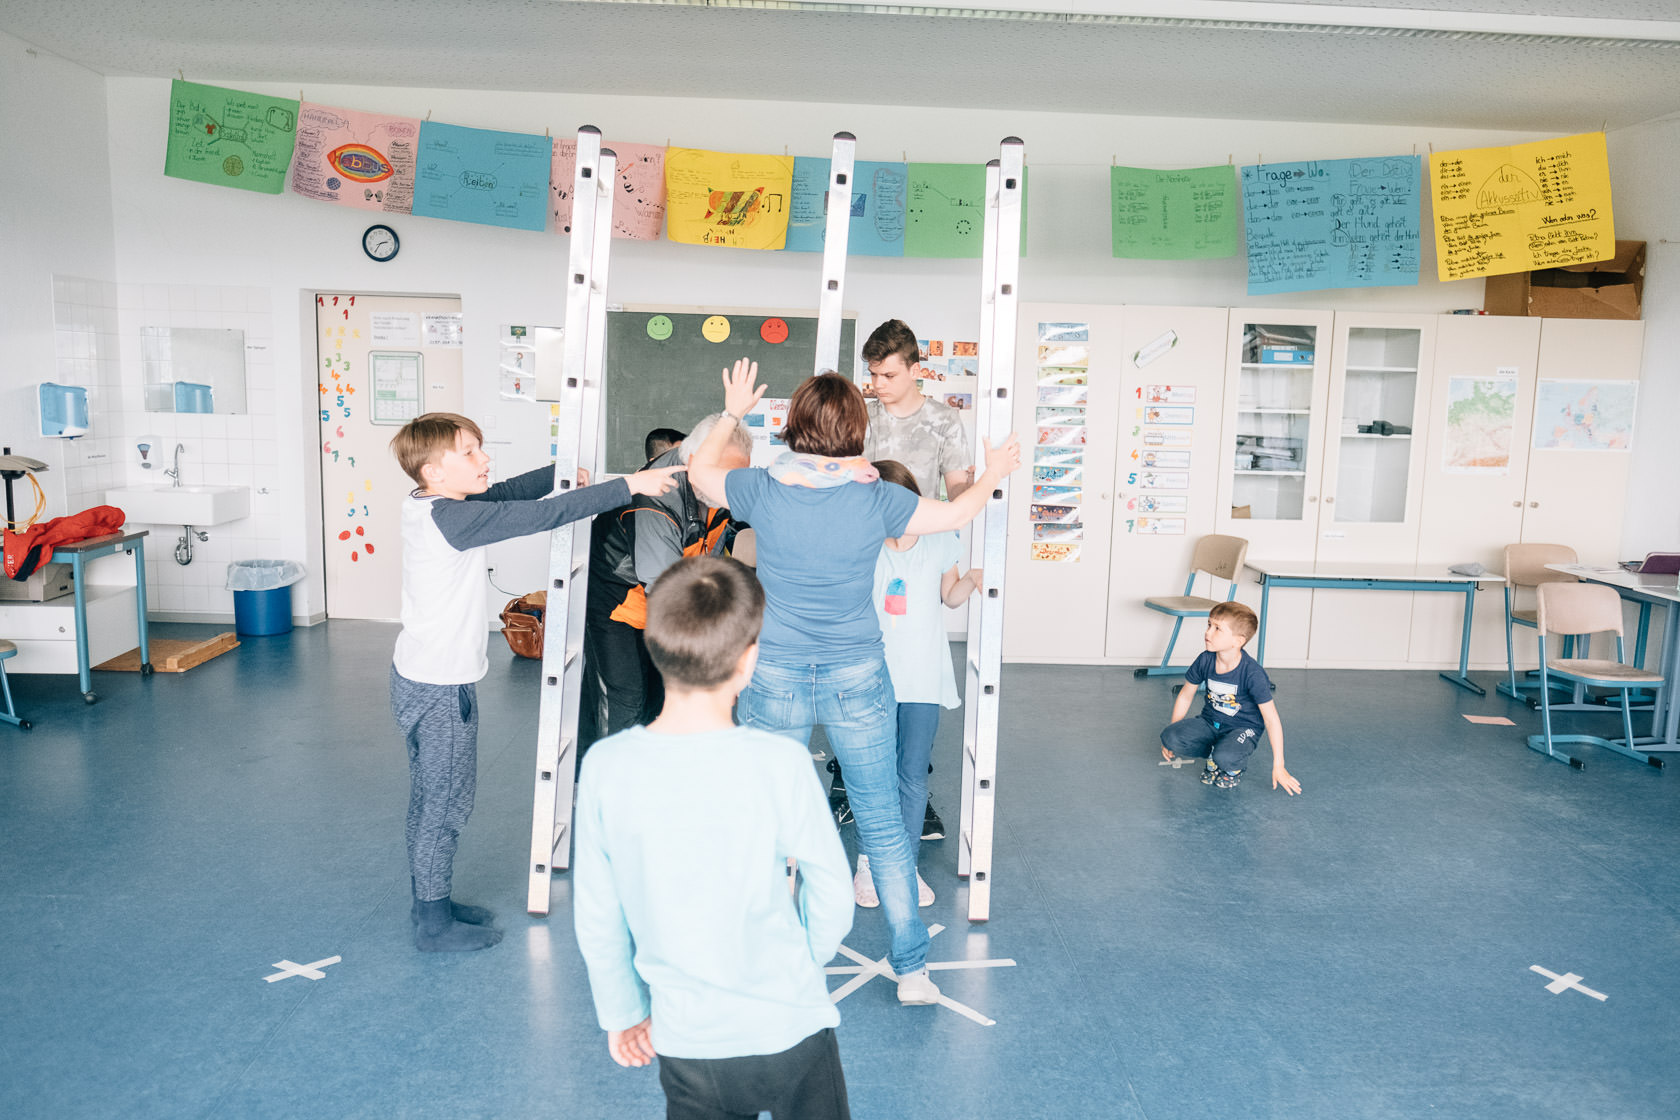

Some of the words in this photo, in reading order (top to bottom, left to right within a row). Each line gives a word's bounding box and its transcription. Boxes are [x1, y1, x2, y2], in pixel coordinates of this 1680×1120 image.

[1257, 164, 1293, 188] Frage
[1577, 208, 1597, 220] was?
[1335, 218, 1350, 230] Der
[1355, 215, 1380, 229] Hund
[1136, 387, 1142, 400] 1
[337, 396, 345, 407] 5
[322, 410, 330, 422] 5
[344, 408, 351, 418] 5
[336, 425, 344, 438] 6
[323, 441, 331, 454] 6
[1130, 449, 1139, 461] 4
[1127, 472, 1138, 485] 5
[1127, 497, 1137, 511] 6
